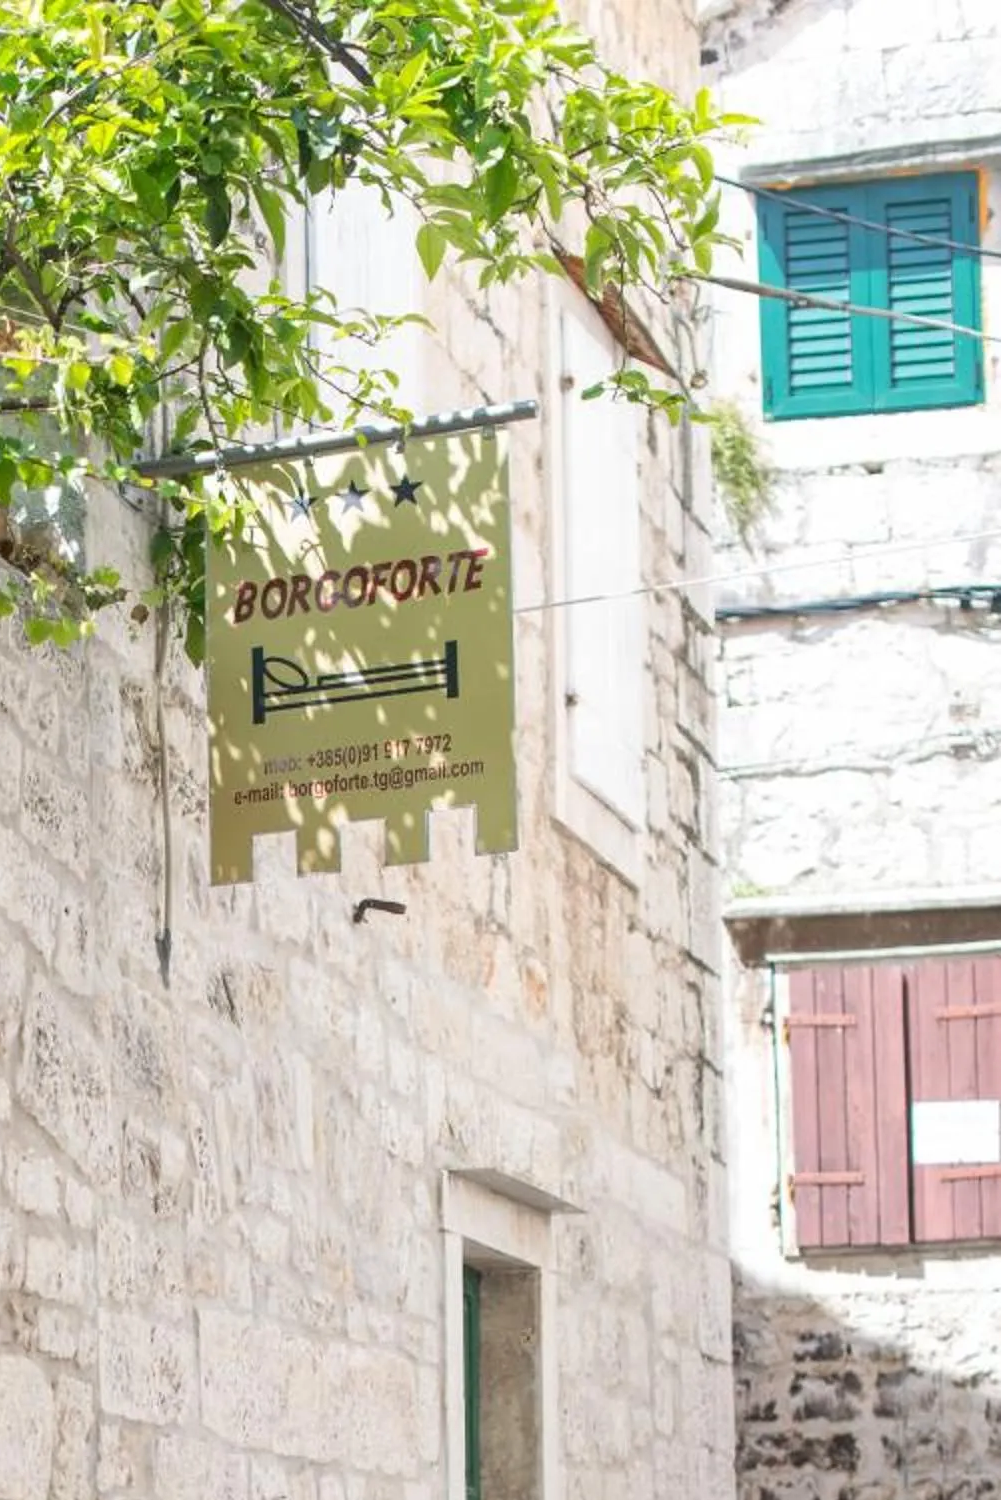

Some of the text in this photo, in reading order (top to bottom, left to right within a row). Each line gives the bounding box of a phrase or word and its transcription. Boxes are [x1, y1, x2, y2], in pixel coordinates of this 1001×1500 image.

[233, 548, 489, 625] BORGOFORTE
[307, 744, 379, 769] +385(0)91
[384, 738, 410, 759] 917
[416, 733, 452, 755] 7972
